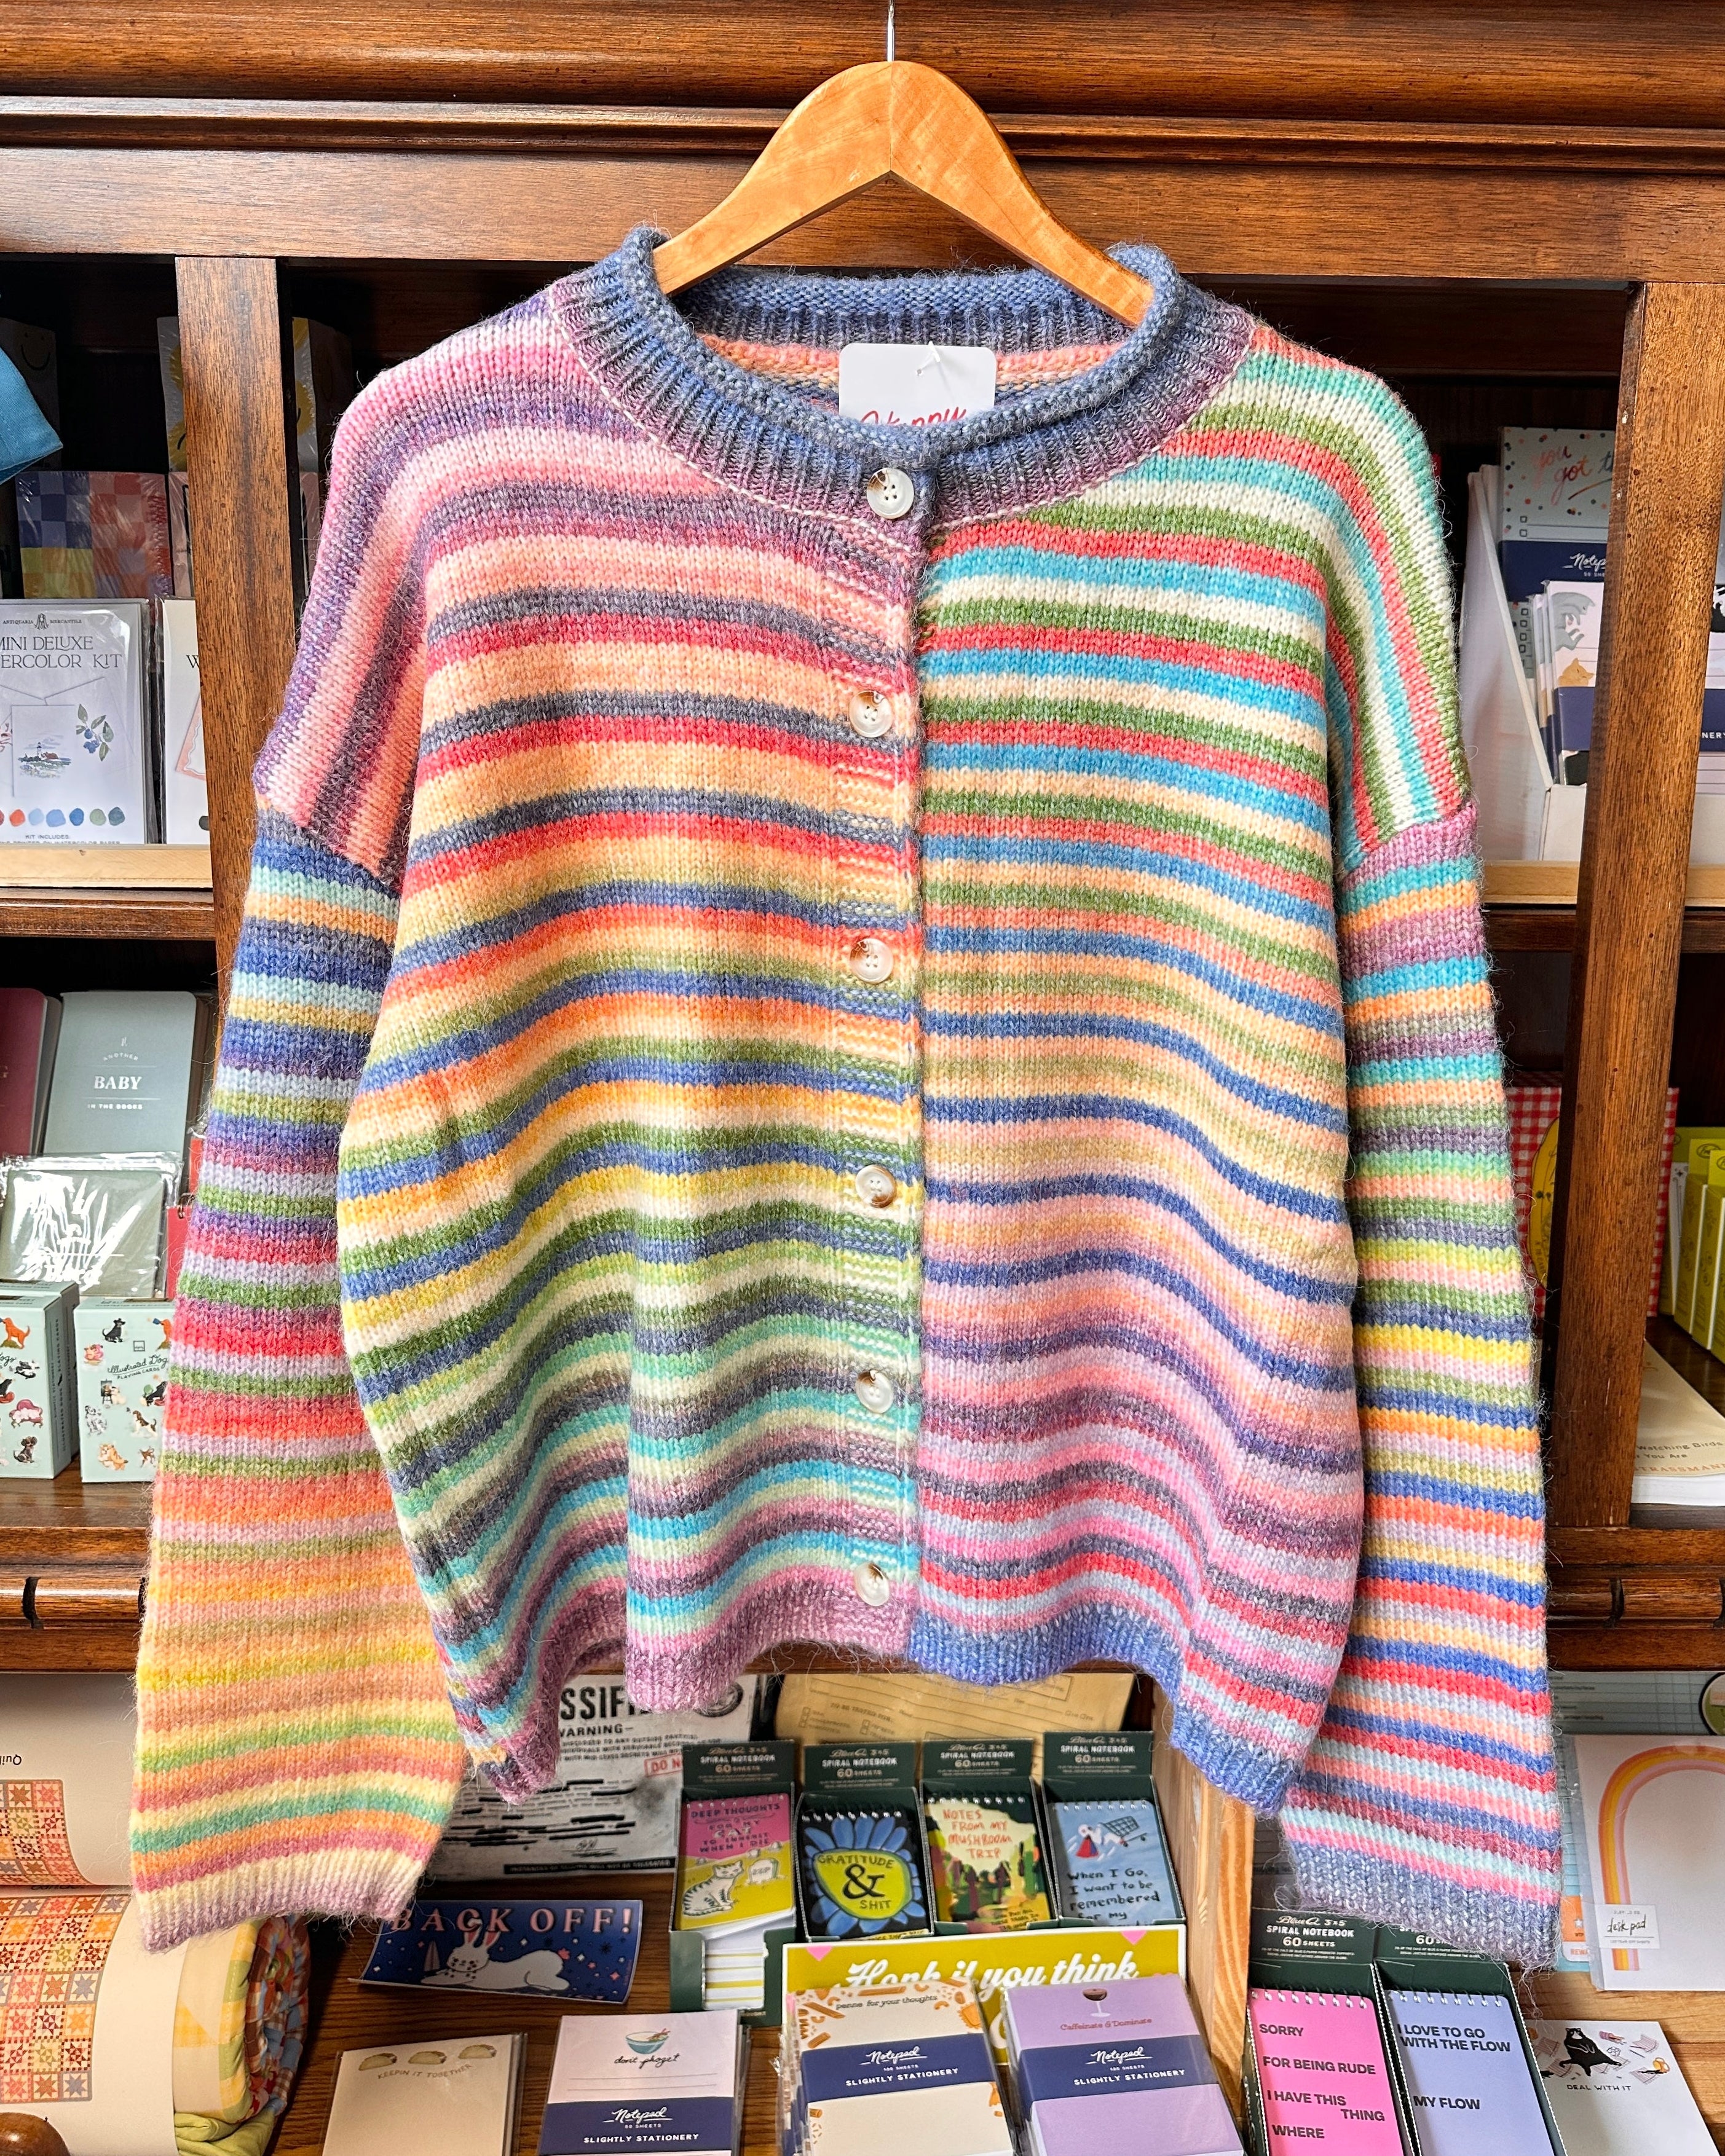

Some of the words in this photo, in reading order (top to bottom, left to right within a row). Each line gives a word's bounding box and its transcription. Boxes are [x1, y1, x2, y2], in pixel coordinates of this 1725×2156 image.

[1551, 455, 1593, 506] got
[33, 636, 93, 651] DELUXE
[93, 654, 123, 669] KIT
[103, 1052, 138, 1061] ANOTHER
[94, 1076, 143, 1090] BABY
[117, 1371, 141, 1379] PLAYING
[1091, 1745, 1135, 1753] NOTEBOOK
[700, 1756, 728, 1765] SPIRAL
[731, 1754, 776, 1763] NOTEBOOK
[853, 1757, 898, 1766] NOTEBOOK
[955, 1760, 971, 1768] 60
[1075, 1754, 1091, 1763] 60
[650, 1759, 668, 1773] DO
[715, 1764, 732, 1774] 60
[837, 1768, 853, 1778] 60
[690, 1809, 720, 1818] DEEP
[724, 1803, 780, 1815] THOUGHTS
[942, 1809, 982, 1819] NOTES
[713, 1827, 751, 1838] CAT
[951, 1821, 985, 1831] FROM
[990, 1820, 1007, 1831] MY
[725, 1832, 768, 1843] INHERIT
[948, 1833, 1012, 1846] MUSHROOM
[699, 1844, 733, 1853] WHEN
[966, 1847, 1001, 1859] TRIP
[817, 1854, 895, 1869] GRATITUDE
[842, 1863, 885, 1899] &
[1067, 1871, 1103, 1880] When
[1109, 1868, 1119, 1878] I
[1069, 1885, 1079, 1895] I
[1083, 1883, 1118, 1892] want
[1121, 1881, 1135, 1890] to
[1138, 1880, 1153, 1889] be
[859, 1899, 891, 1910] SHIT
[1070, 1890, 1161, 1911] remembered
[391, 1908, 512, 1932] BACK
[530, 1907, 632, 1934] OFF!
[1108, 1911, 1127, 1921] my
[1266, 1924, 1300, 1935] SPIRAL
[1303, 1927, 1355, 1938] NOTEBOOK
[1606, 1917, 1629, 1934] desk
[1628, 1913, 1646, 1936] pad
[1282, 1936, 1302, 1947] 60
[977, 1965, 1047, 2002] you
[1053, 1949, 1140, 1983] think
[880, 1999, 901, 2008] your
[902, 1994, 938, 2004] thoughts
[1111, 2018, 1153, 2027] Dominate
[1259, 2023, 1304, 2036] SORRY
[1397, 2023, 1402, 2034] I
[1403, 2024, 1440, 2036] LOVE
[1442, 2027, 1462, 2037] TO
[1464, 2028, 1485, 2039] GO
[1400, 2036, 1439, 2048] WITH
[1439, 2039, 1469, 2050] THE
[1470, 2040, 1510, 2052] FLOW
[864, 2045, 923, 2064] Notepad
[1089, 2046, 1147, 2064] Notepad
[377, 2069, 410, 2079] KEEPIN
[427, 2063, 473, 2078] TOGETHER
[1263, 2056, 1291, 2068] FOR
[1293, 2058, 1335, 2072] BEING
[1337, 2062, 1376, 2075] RUDE
[845, 2075, 893, 2087] SLIGHTLY
[897, 2067, 959, 2080] STATIONERY
[1073, 2075, 1121, 2085] SLIGHTLY
[1124, 2069, 1186, 2080] STATIONERY
[1267, 2090, 1272, 2100] I
[1274, 2090, 1312, 2103] HAVE
[1314, 2093, 1347, 2106] THIS
[1413, 2095, 1436, 2107] MY
[1439, 2097, 1480, 2110] FLOW
[610, 2106, 669, 2125] Notepad
[1341, 2108, 1386, 2122] THING
[636, 2133, 699, 2142] STATIONERY
[1272, 2124, 1325, 2139] WHERE
